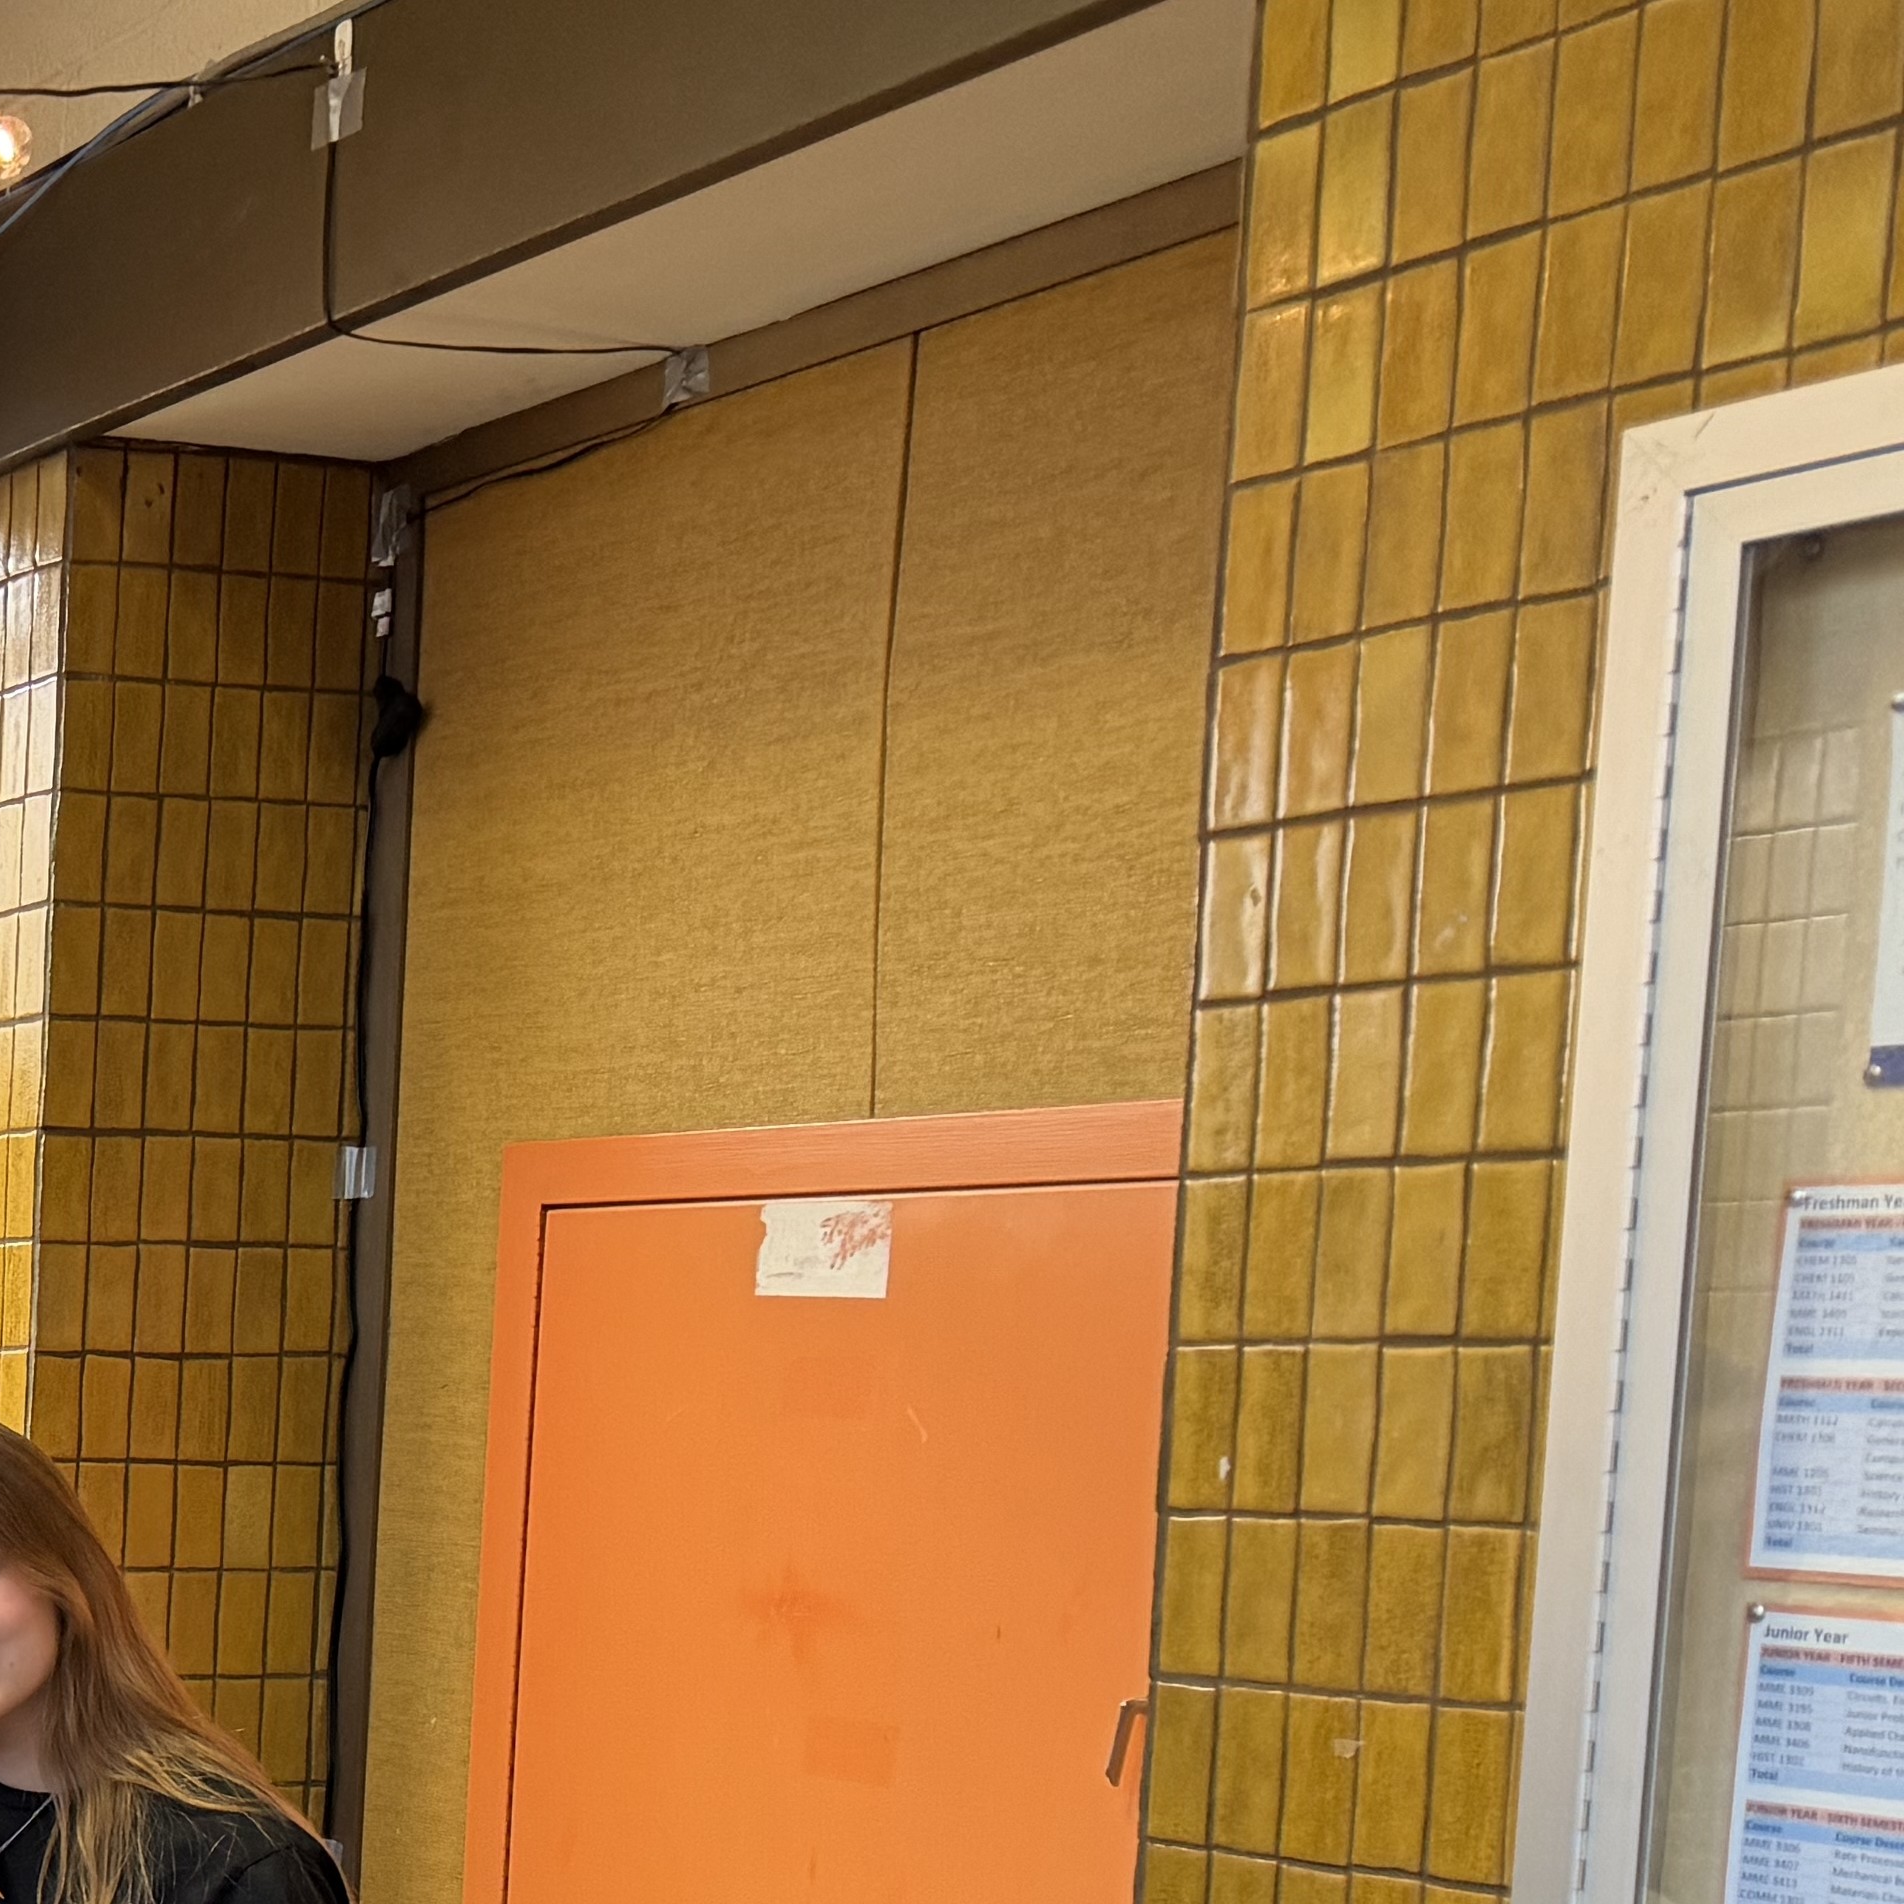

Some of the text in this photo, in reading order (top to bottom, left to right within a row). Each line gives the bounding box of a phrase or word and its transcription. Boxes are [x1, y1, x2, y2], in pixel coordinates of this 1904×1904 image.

[1804, 1196, 1880, 1210] Freshman
[1764, 1625, 1848, 1644] Junior Year
[1849, 1673, 1886, 1684] Course
[1745, 1821, 1782, 1833] Course
[1860, 1817, 1904, 1831] SEMEST
